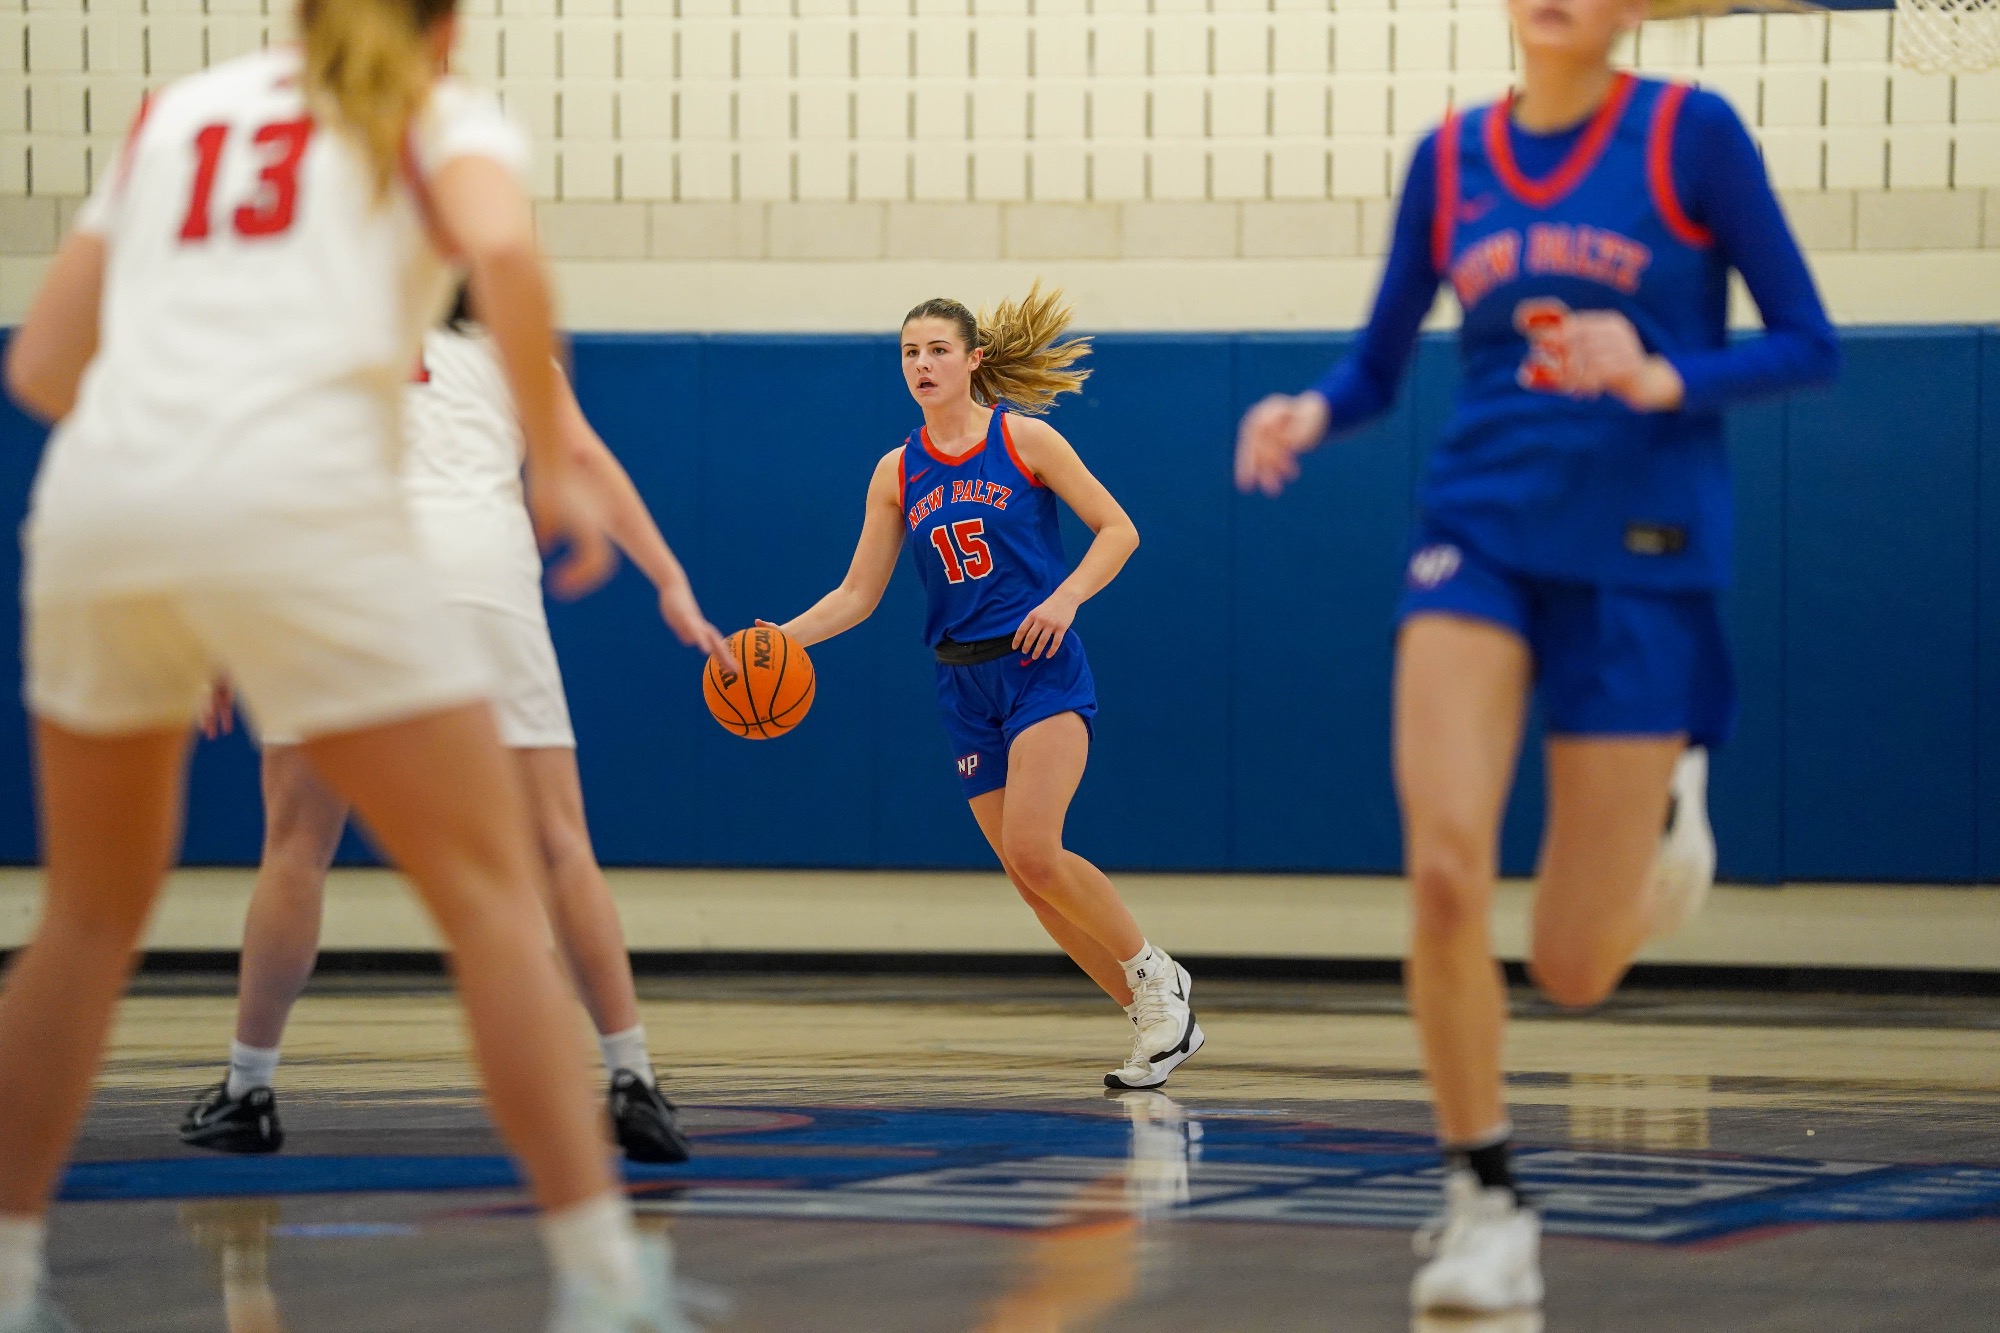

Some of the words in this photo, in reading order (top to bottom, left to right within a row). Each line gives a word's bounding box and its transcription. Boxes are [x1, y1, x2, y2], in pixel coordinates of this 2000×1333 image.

[178, 115, 316, 243] 13
[908, 484, 945, 531] NEW
[951, 479, 1013, 511] PALTZ
[930, 518, 994, 585] 15
[956, 752, 979, 777] NP
